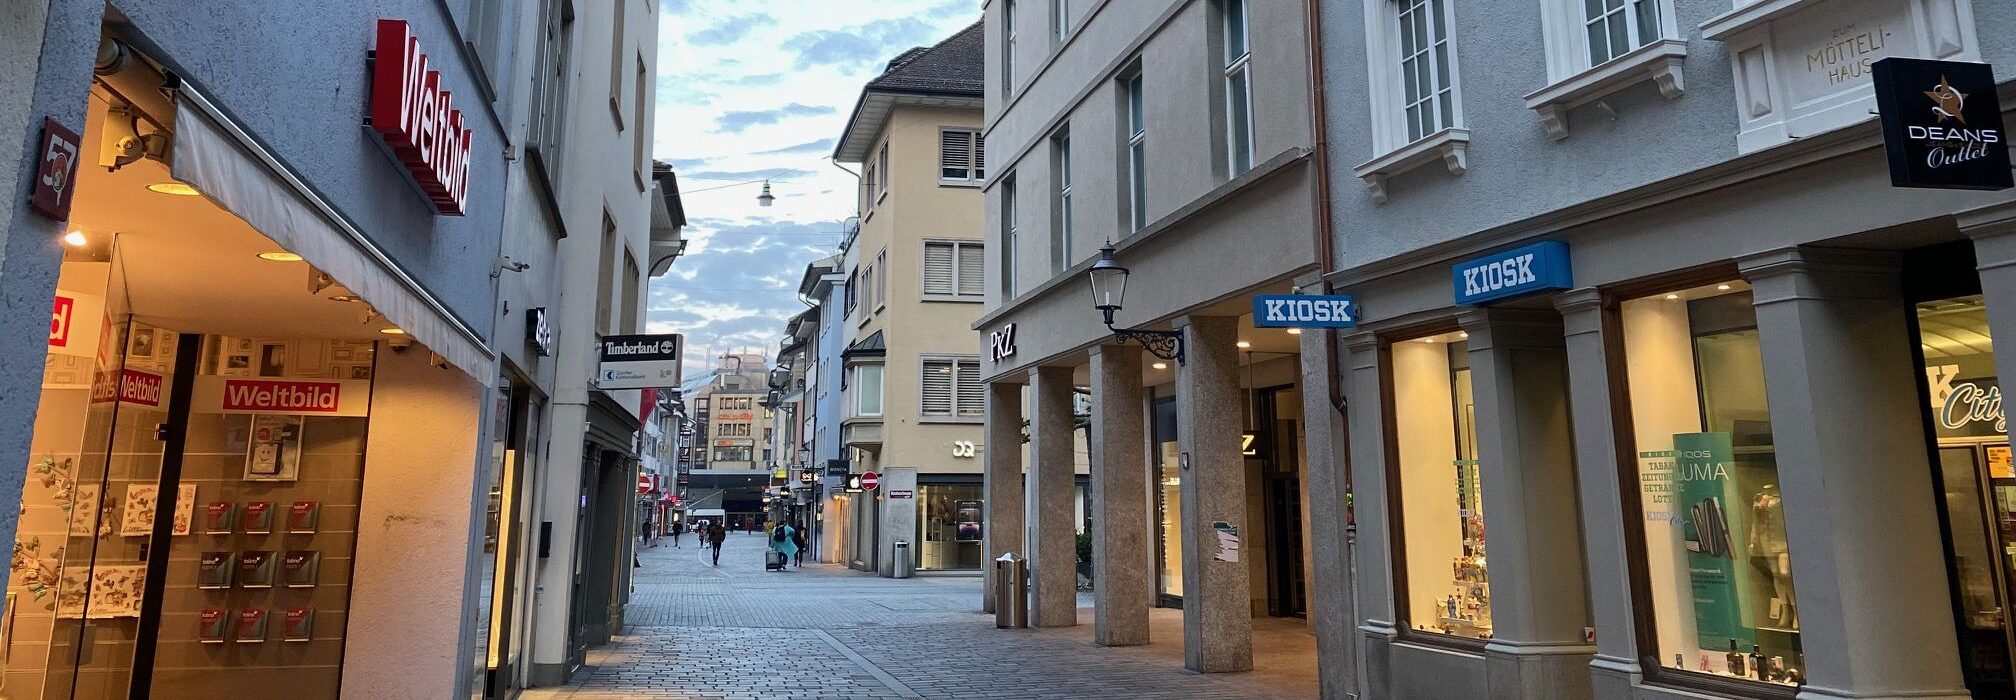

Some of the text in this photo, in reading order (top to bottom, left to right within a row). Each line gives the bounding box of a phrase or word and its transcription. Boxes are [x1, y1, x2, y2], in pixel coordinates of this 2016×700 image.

[1833, 23, 1856, 38] ZUM
[400, 22, 473, 216] Weltbild
[1908, 126, 1998, 142] DEANS
[1927, 140, 1989, 168] Outlet
[43, 133, 77, 207] 57
[1463, 253, 1536, 296] KIOSK
[1265, 299, 1351, 322] KIOSK
[605, 341, 659, 356] Timberland
[990, 323, 1013, 361] PKZ
[229, 384, 336, 409] Weltbild
[1941, 382, 2008, 433] City
